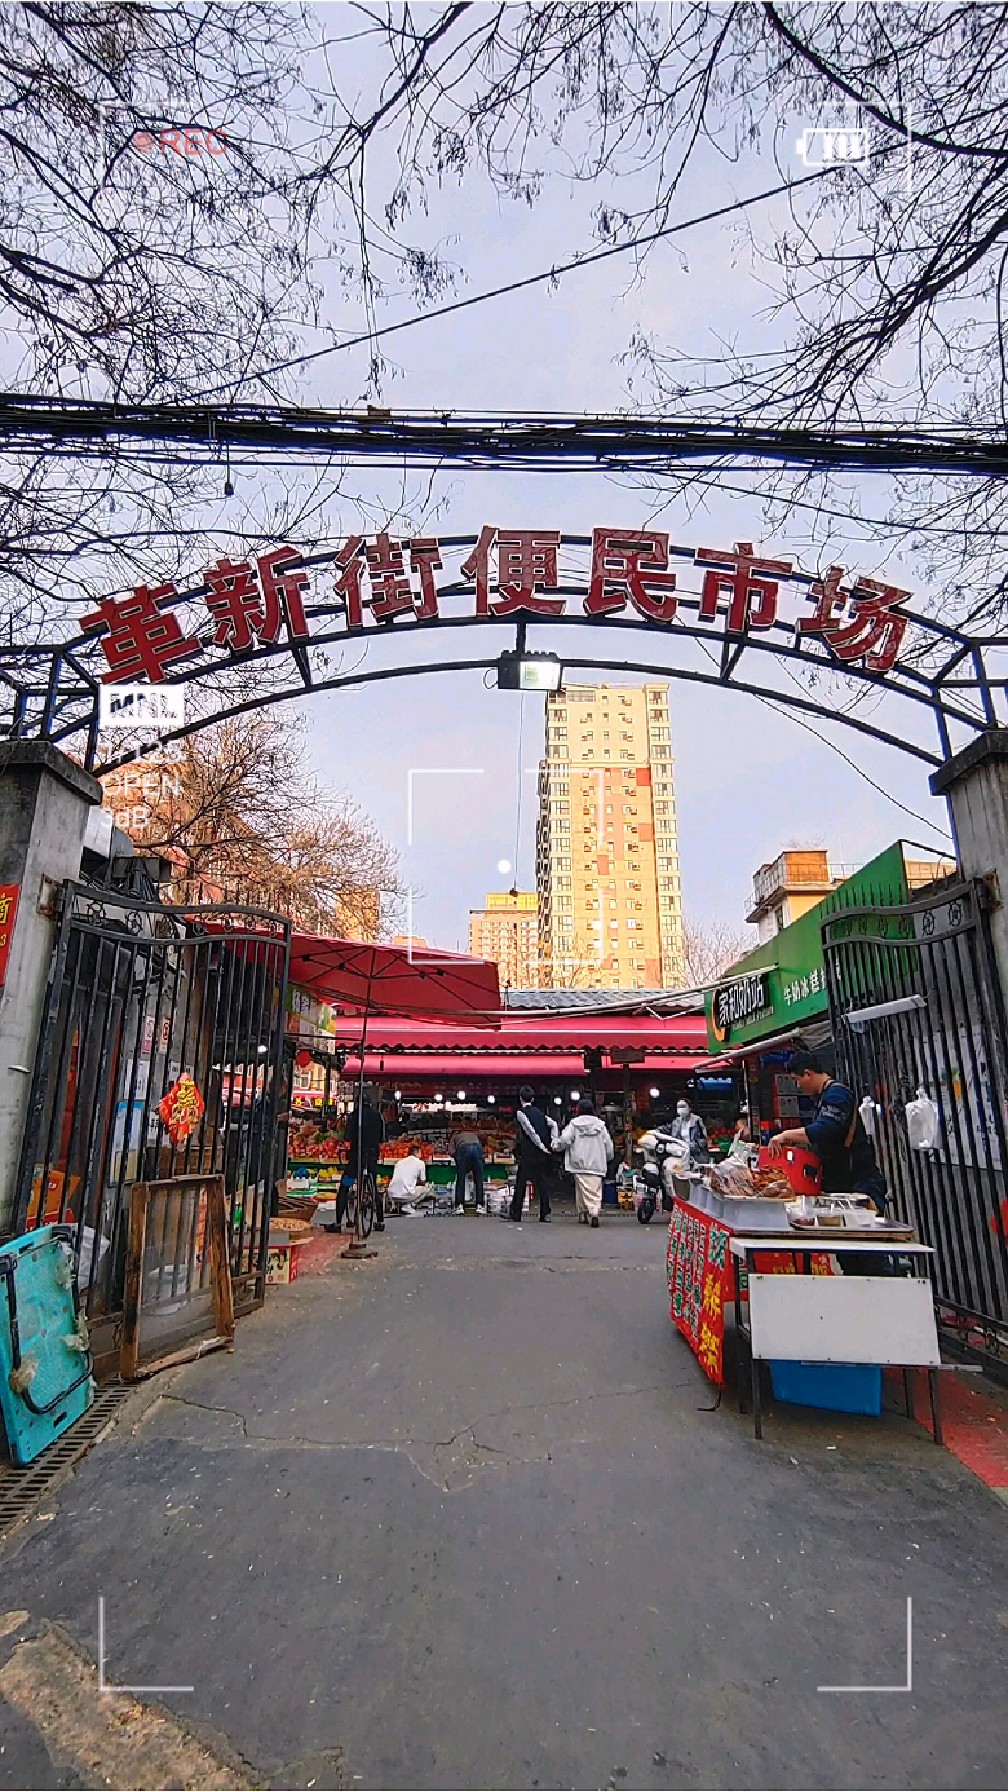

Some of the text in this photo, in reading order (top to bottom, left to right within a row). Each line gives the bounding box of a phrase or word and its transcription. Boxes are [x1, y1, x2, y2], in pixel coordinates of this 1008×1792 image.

[79, 524, 913, 685] 革新街便民市场
